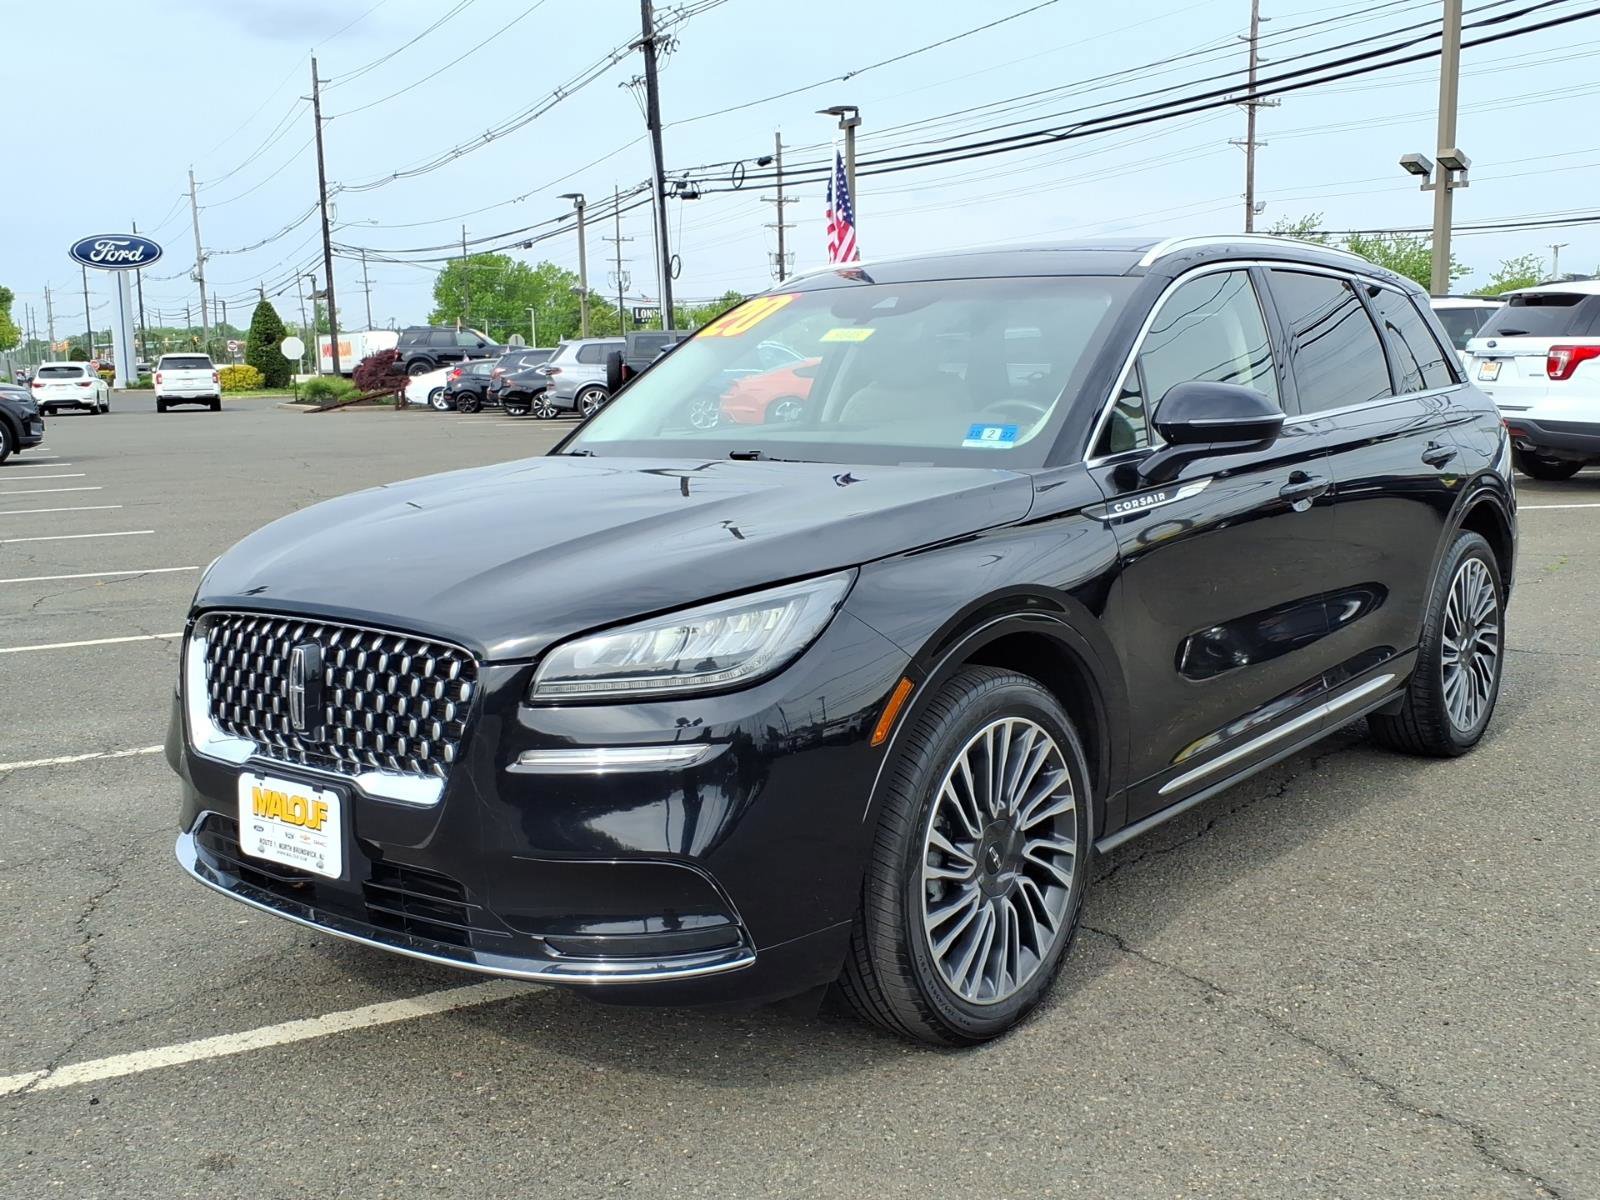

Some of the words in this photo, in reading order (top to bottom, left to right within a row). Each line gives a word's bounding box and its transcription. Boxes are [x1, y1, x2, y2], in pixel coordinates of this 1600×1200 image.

[90, 240, 144, 261] Ford
[987, 429, 996, 438] 2
[1114, 492, 1166, 512] CORSAIR
[252, 787, 328, 831] MALOUF
[259, 837, 273, 847] ROUTE
[278, 842, 292, 852] NORTH
